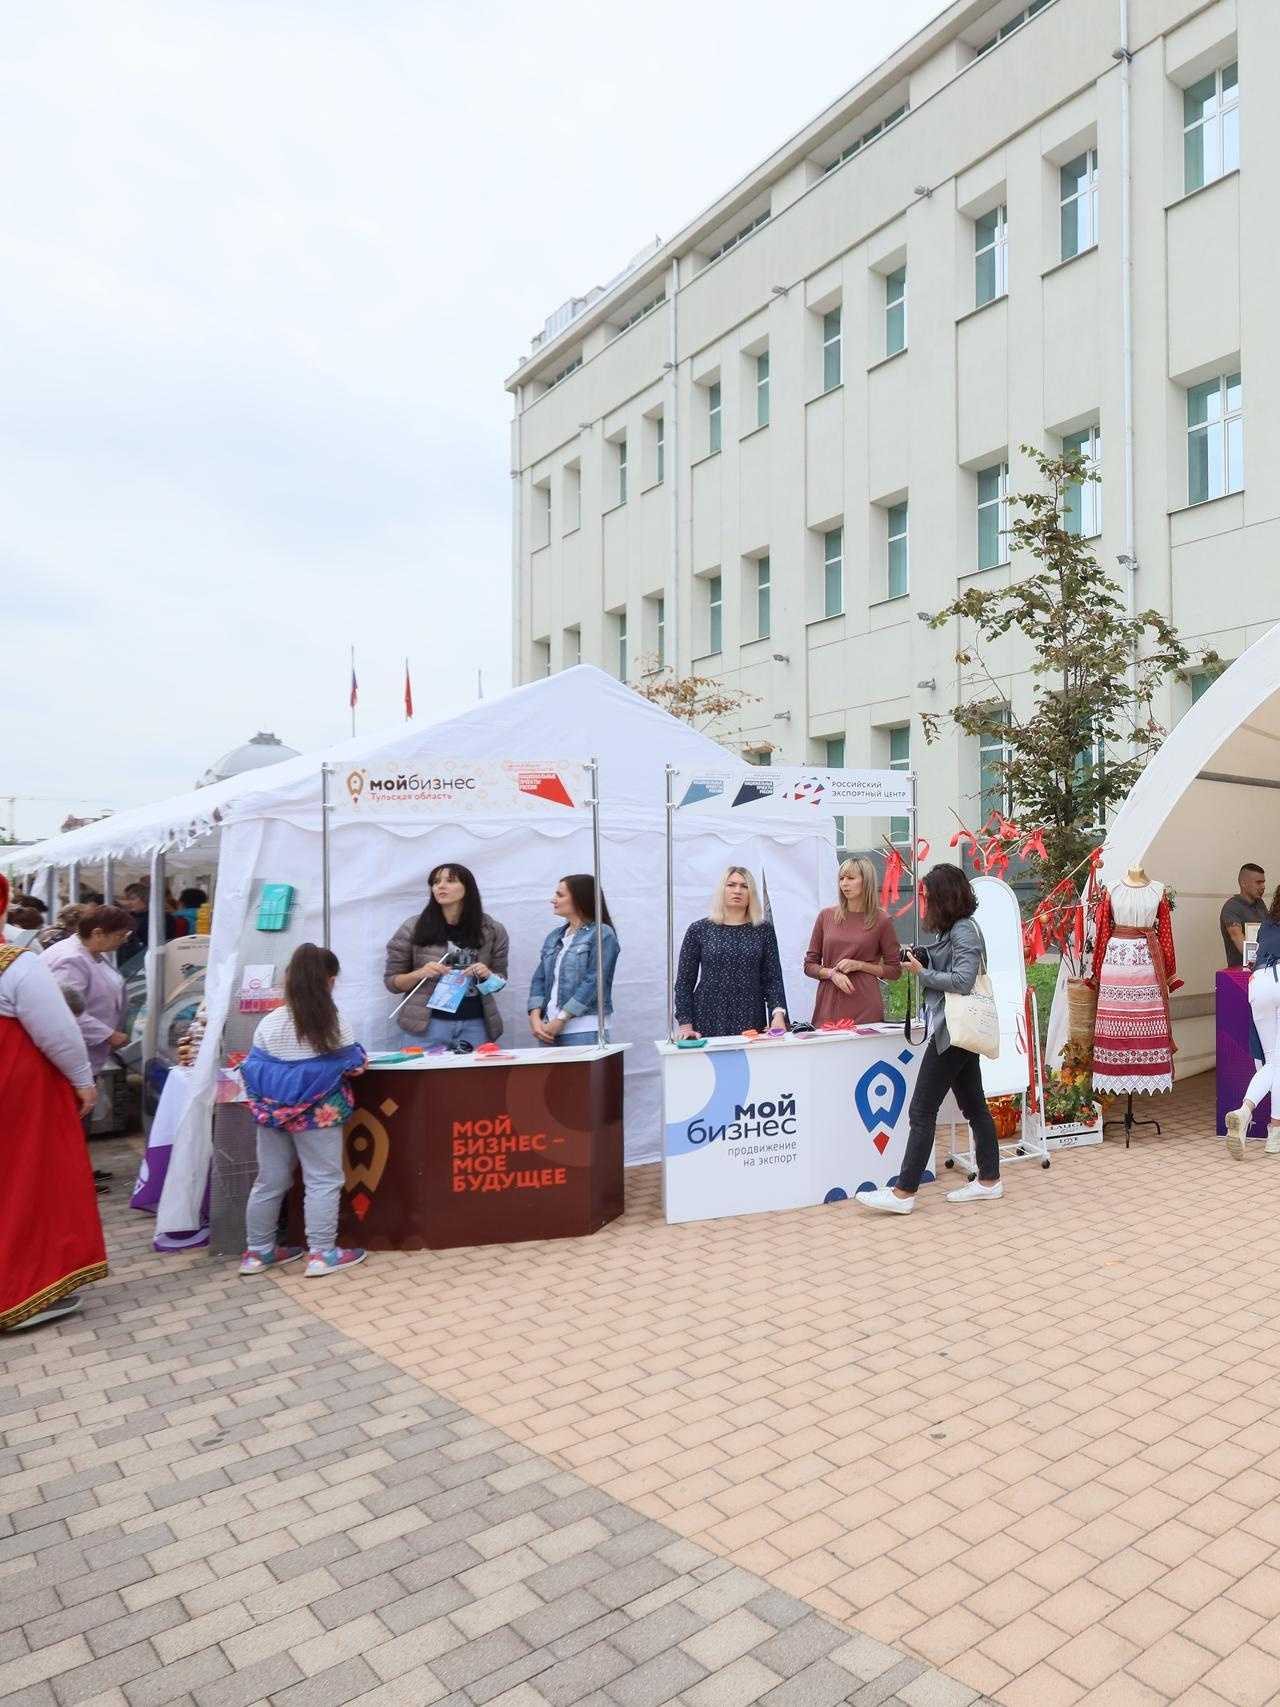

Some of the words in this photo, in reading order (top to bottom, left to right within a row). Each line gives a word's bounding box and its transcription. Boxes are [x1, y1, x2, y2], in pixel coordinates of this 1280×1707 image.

[371, 792, 412, 801] Тульская
[414, 792, 453, 800] область
[734, 1093, 796, 1120] мой
[453, 1115, 511, 1137] МОЙ
[687, 1118, 797, 1144] бизнес
[452, 1134, 547, 1156] БИЗНЕС
[728, 1141, 797, 1158] продвижение
[453, 1155, 507, 1174] МОЕ
[743, 1157, 755, 1166] на
[759, 1153, 797, 1165] экспорт
[452, 1168, 567, 1192] БУДУЩЕЕ
